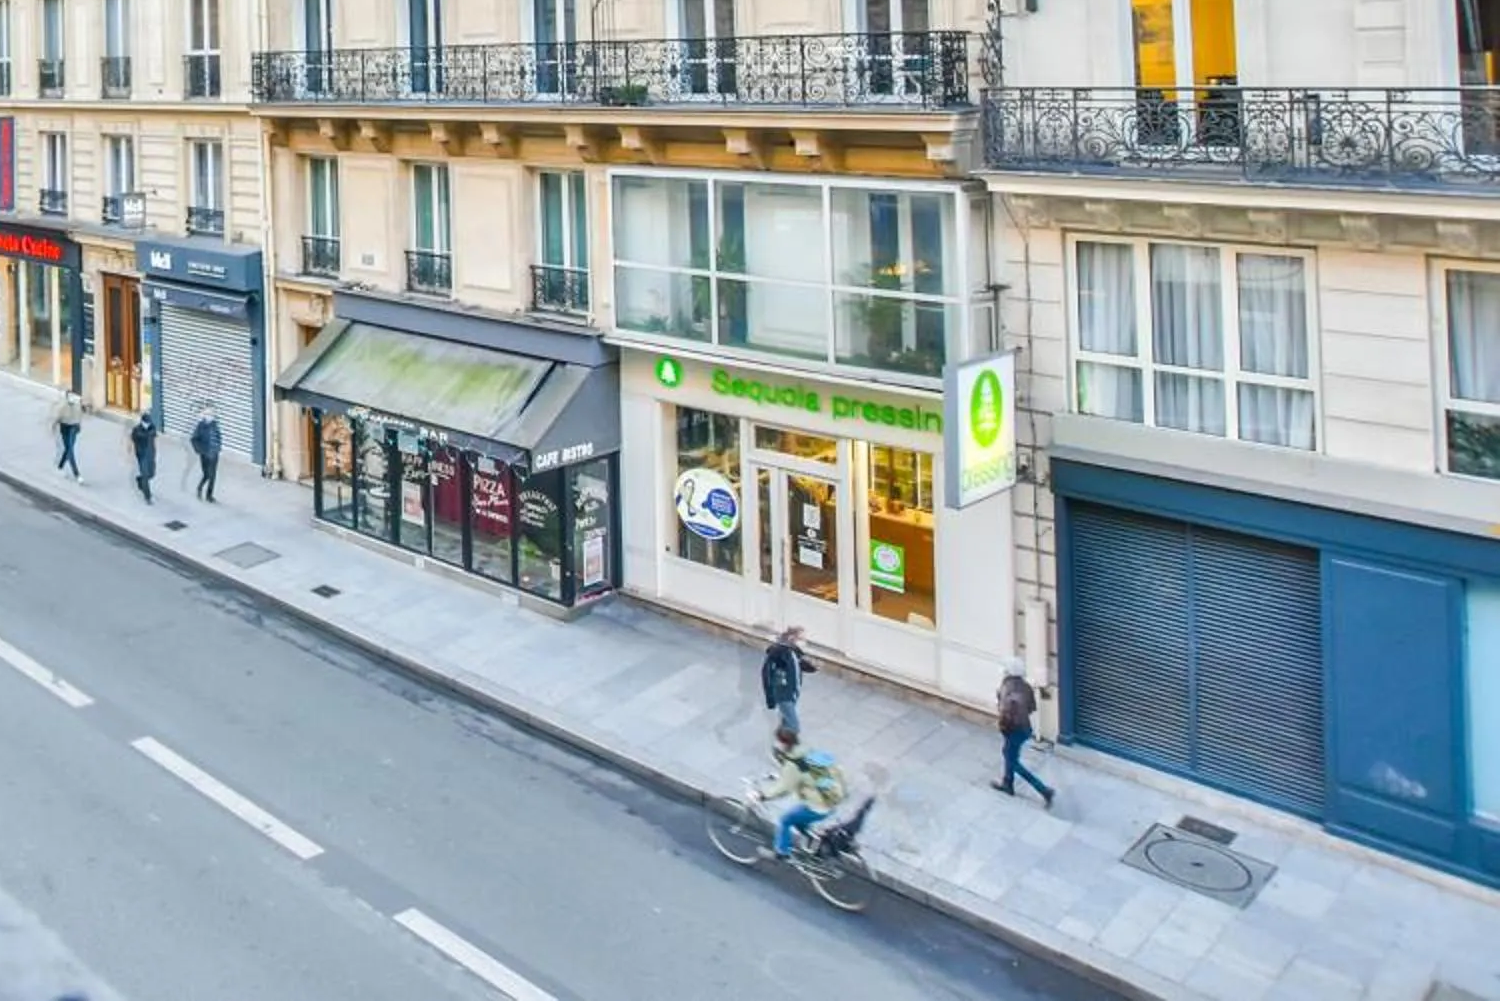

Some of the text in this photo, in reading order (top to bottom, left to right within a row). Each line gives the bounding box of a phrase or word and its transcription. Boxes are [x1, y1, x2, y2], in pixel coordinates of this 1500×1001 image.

[711, 367, 942, 434] Sequoia pressin
[562, 442, 594, 463] BISTRO
[473, 473, 506, 498] PIZZA
